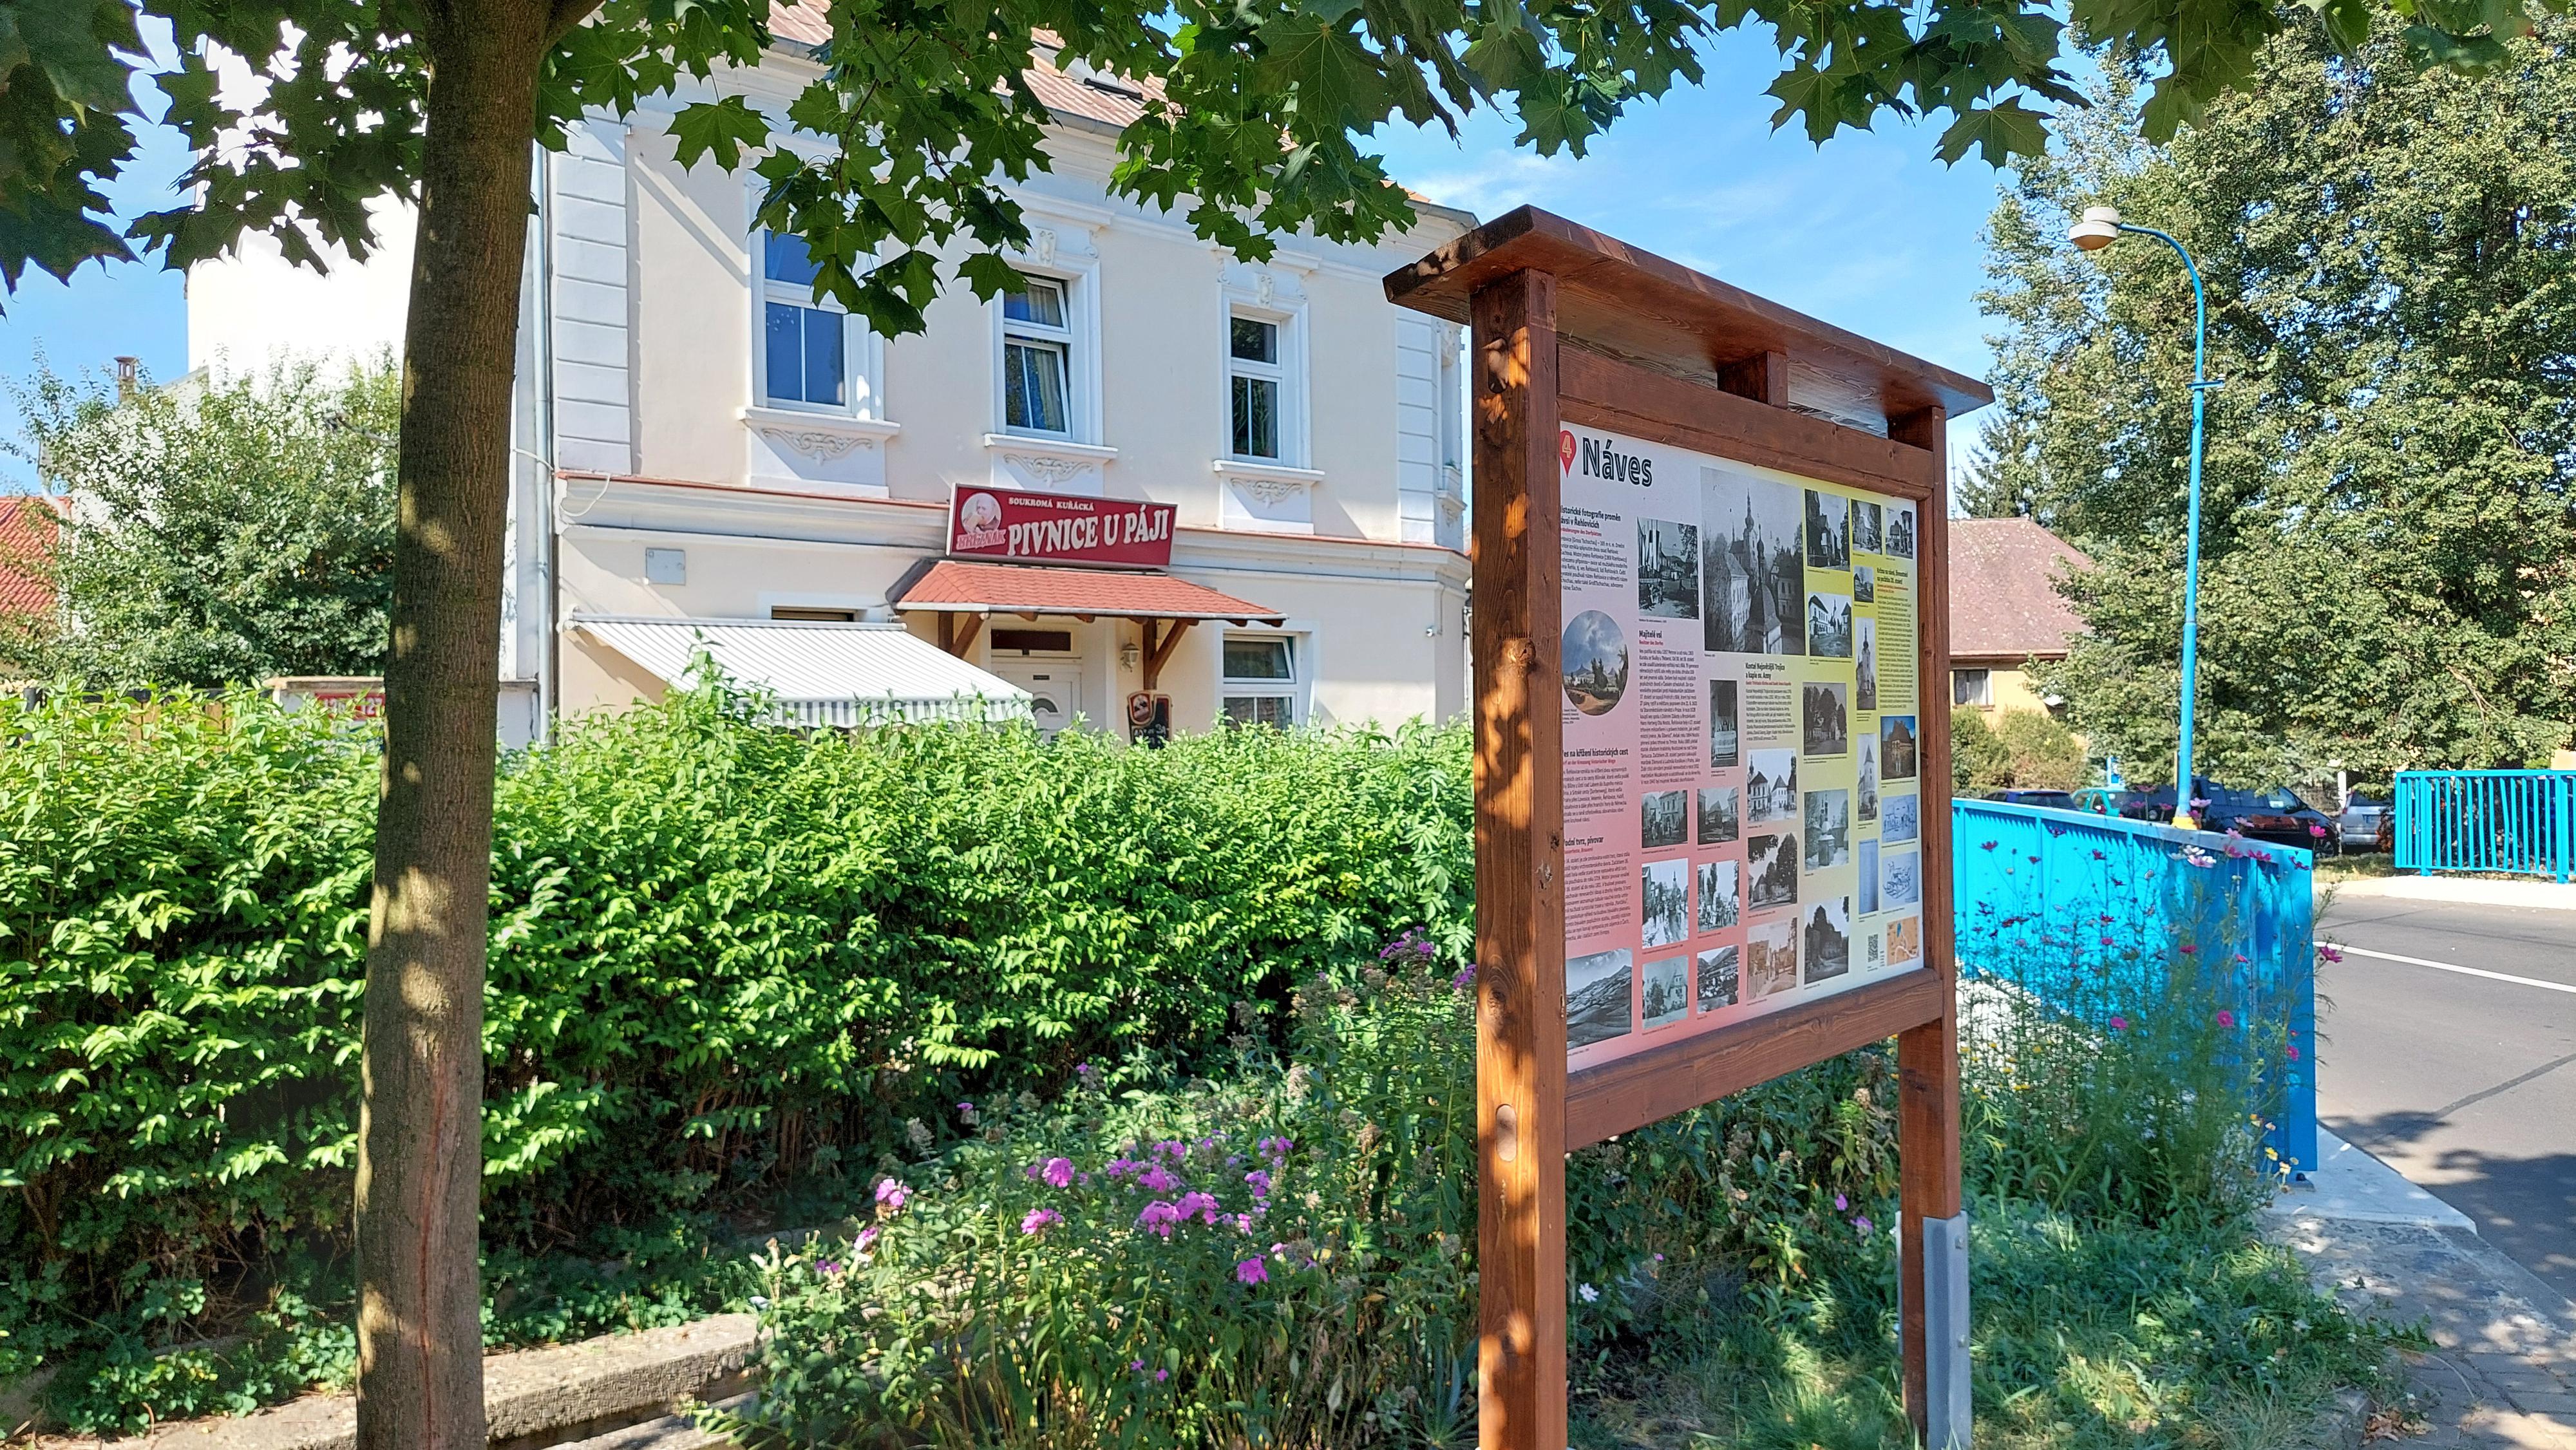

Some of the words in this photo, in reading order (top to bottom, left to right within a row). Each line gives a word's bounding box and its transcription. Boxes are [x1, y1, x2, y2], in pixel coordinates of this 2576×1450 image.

[1562, 435, 1572, 458] 4
[1582, 437, 1653, 487] Náves
[1009, 497, 1053, 507] SOUKROMÁ
[1057, 500, 1094, 511] KUŘÁCKÁ
[1582, 508, 1604, 520] fotografie
[1605, 513, 1621, 522] proměn
[1574, 516, 1600, 529] Řehlovicích
[1007, 516, 1098, 557] PIVNICE
[1104, 513, 1120, 546] U
[1123, 504, 1170, 544] PÁJI
[1639, 630, 1655, 639] Majitelé
[1593, 748, 1618, 758] historických
[1587, 836, 1604, 846] pivovar
